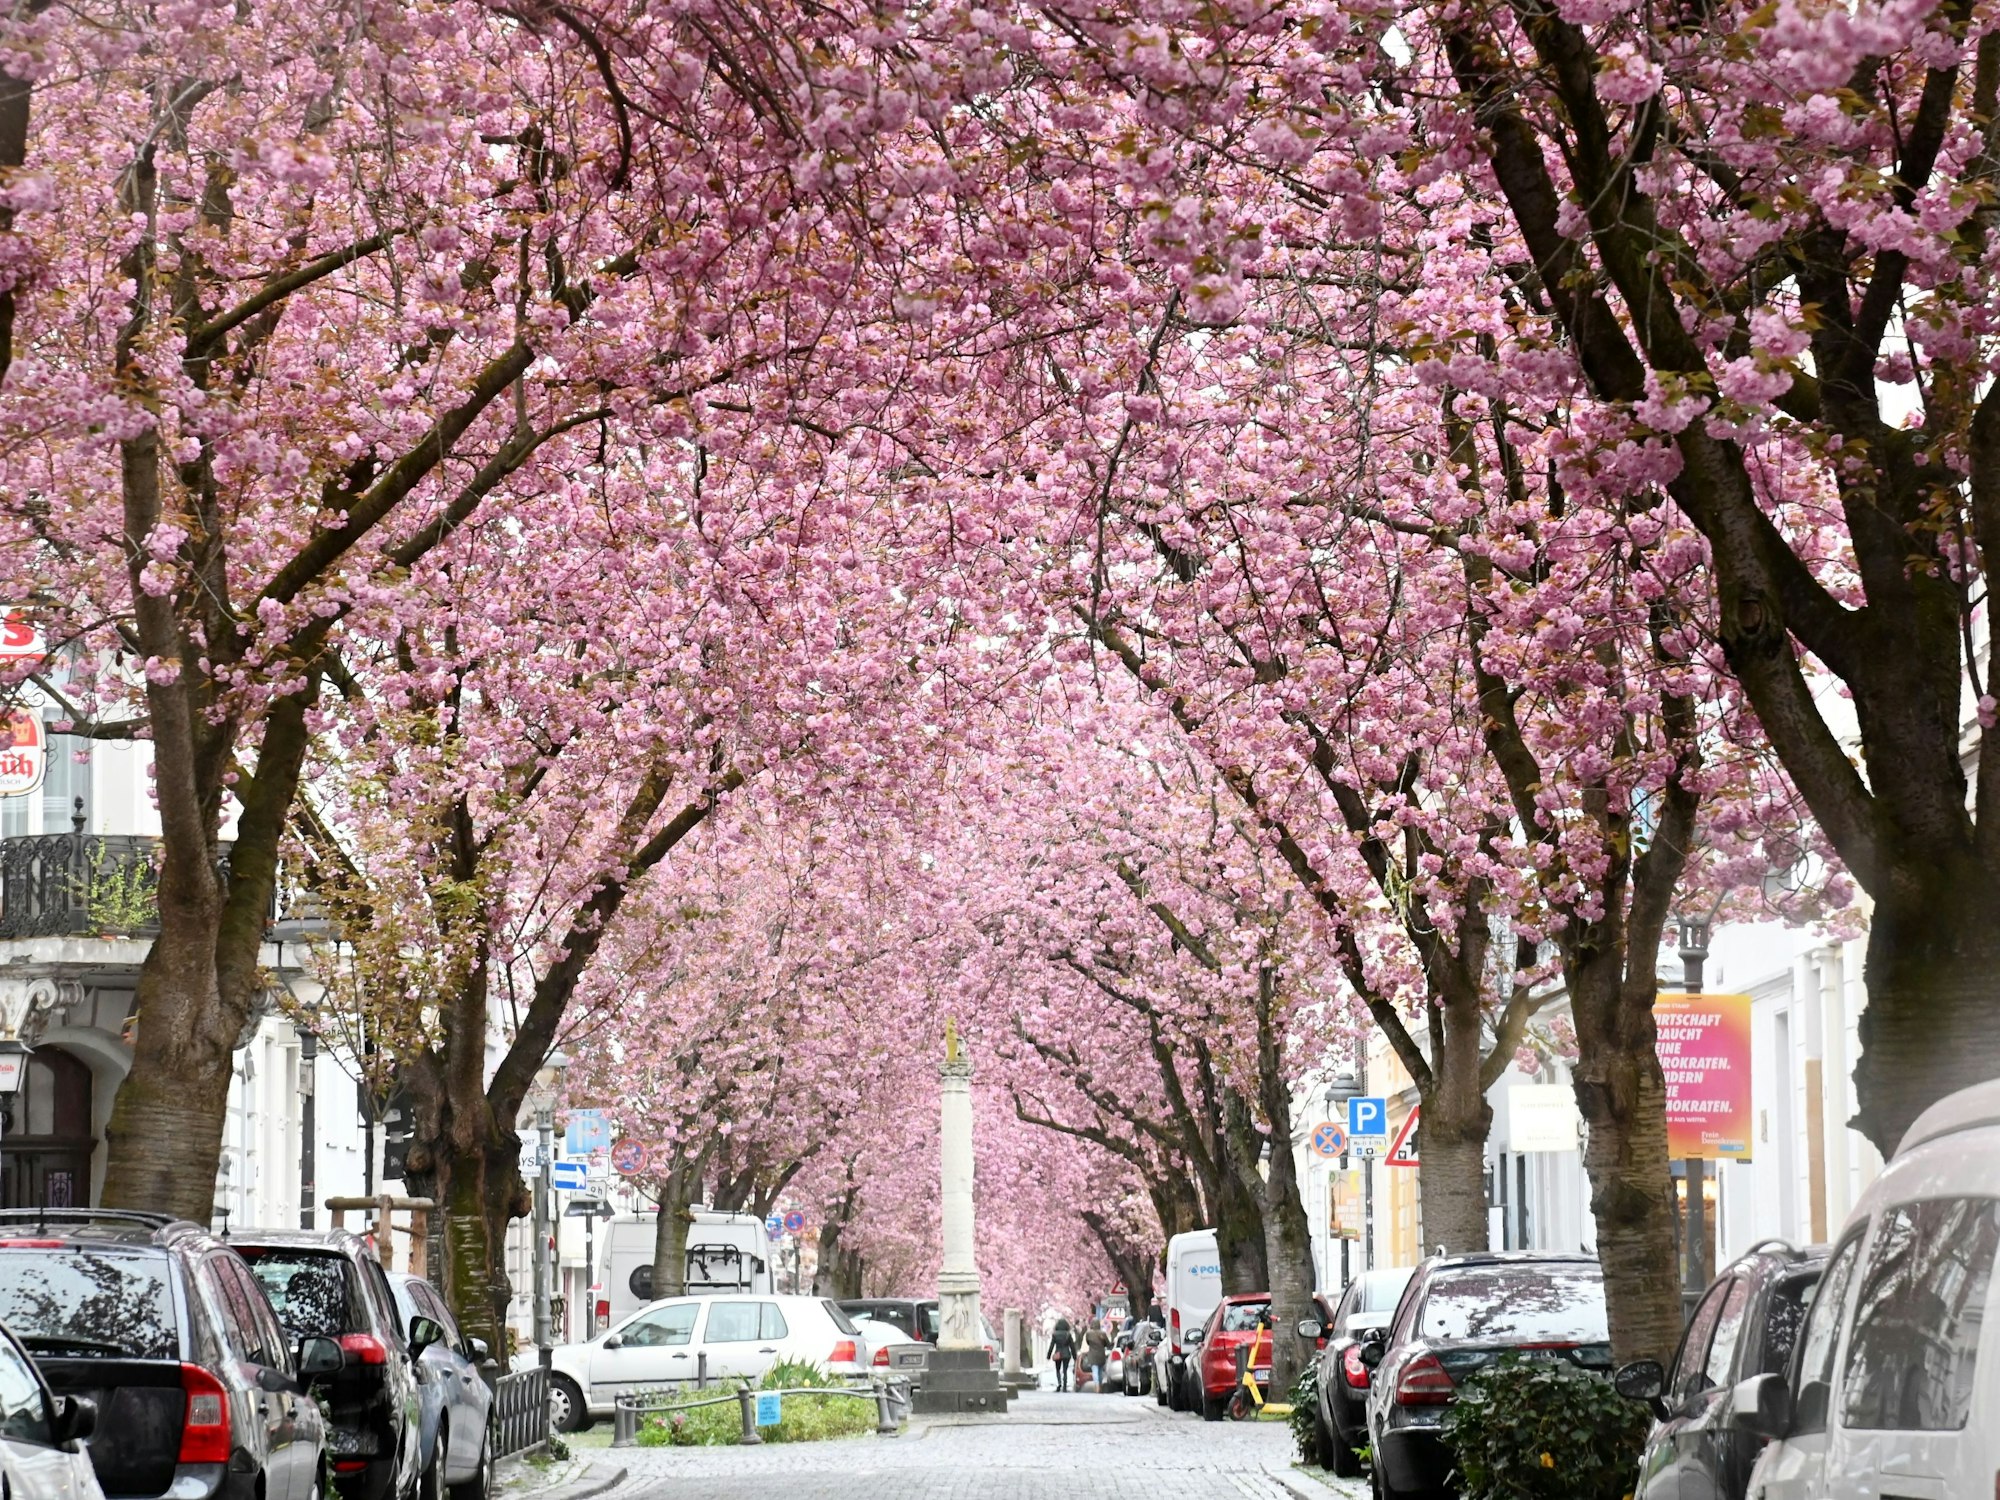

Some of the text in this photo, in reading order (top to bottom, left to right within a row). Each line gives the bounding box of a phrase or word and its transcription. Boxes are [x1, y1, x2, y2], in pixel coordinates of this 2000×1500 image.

[0, 753, 33, 777] üh
[1657, 1028, 1702, 1040] RAUCHT
[1655, 1042, 1681, 1054] EINE
[1657, 1056, 1731, 1069] ROKRATEN.
[1663, 1071, 1703, 1083] NDERN
[1666, 1085, 1679, 1097] IE
[1665, 1100, 1732, 1112] MOKRATEN.
[1357, 1102, 1377, 1131] P
[521, 1157, 535, 1168] YS
[1200, 1265, 1221, 1273] POL
